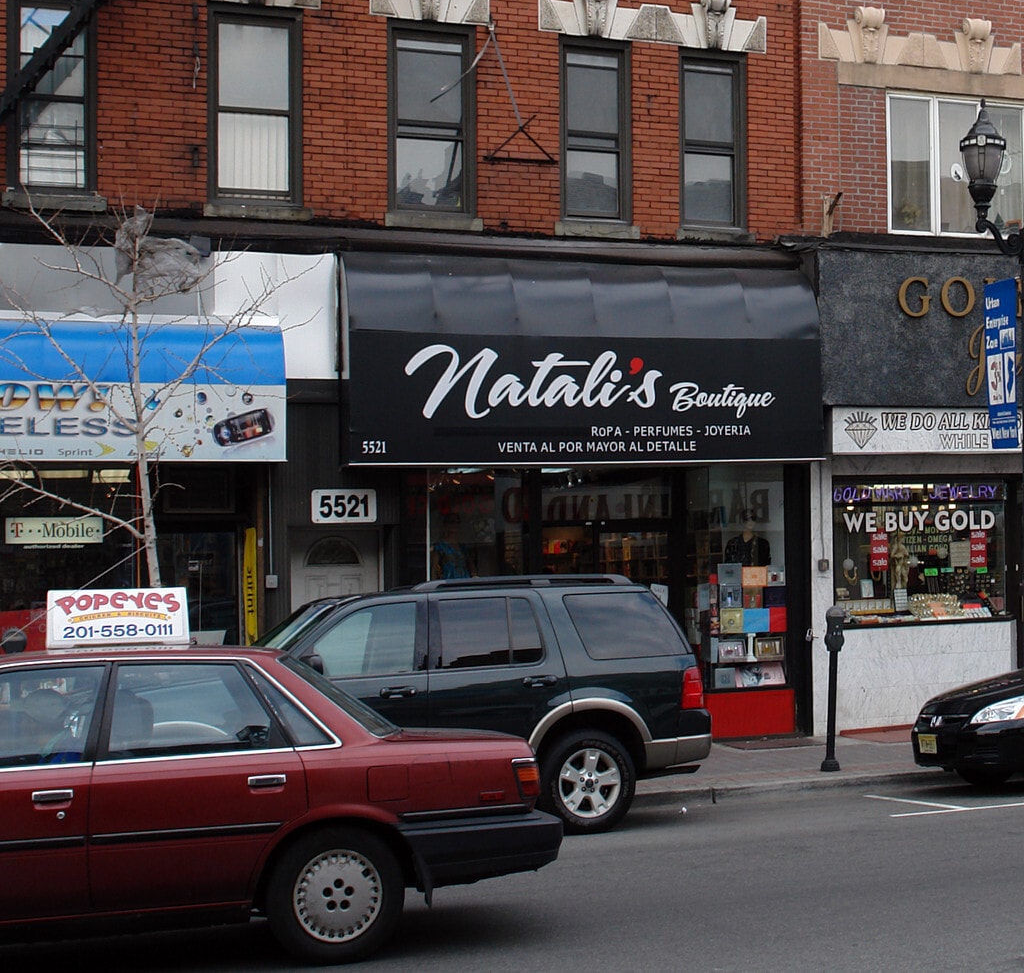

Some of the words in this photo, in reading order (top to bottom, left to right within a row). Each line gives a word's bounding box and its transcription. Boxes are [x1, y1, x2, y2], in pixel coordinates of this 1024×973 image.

[986, 336, 998, 349] Zone
[404, 344, 663, 419] Natali's
[669, 381, 776, 418] Boutique
[880, 412, 907, 430] WE
[910, 412, 936, 430] DO
[938, 413, 970, 430] ALL
[633, 425, 693, 437] PERFUMES
[704, 425, 751, 436] JOYERIA
[362, 440, 387, 454] 5521
[498, 441, 538, 453] VENTA
[541, 442, 556, 453] AL
[559, 441, 583, 452] POR
[586, 441, 626, 452] MAYOR
[629, 441, 644, 452] AL
[647, 440, 697, 451] DETALLE
[939, 433, 989, 449] WHILE
[57, 448, 94, 457] Sprint
[929, 485, 998, 501] JEWELRY
[319, 494, 369, 518] 5521
[843, 512, 877, 533] WE
[885, 511, 929, 533] BUY
[934, 510, 995, 531] GOLD
[872, 532, 888, 541] sale
[970, 530, 986, 538] sale
[872, 545, 888, 554] sale
[970, 542, 986, 551] sale
[872, 558, 888, 567] sale
[970, 555, 986, 564] sale
[63, 624, 173, 639] 201-558-0111
